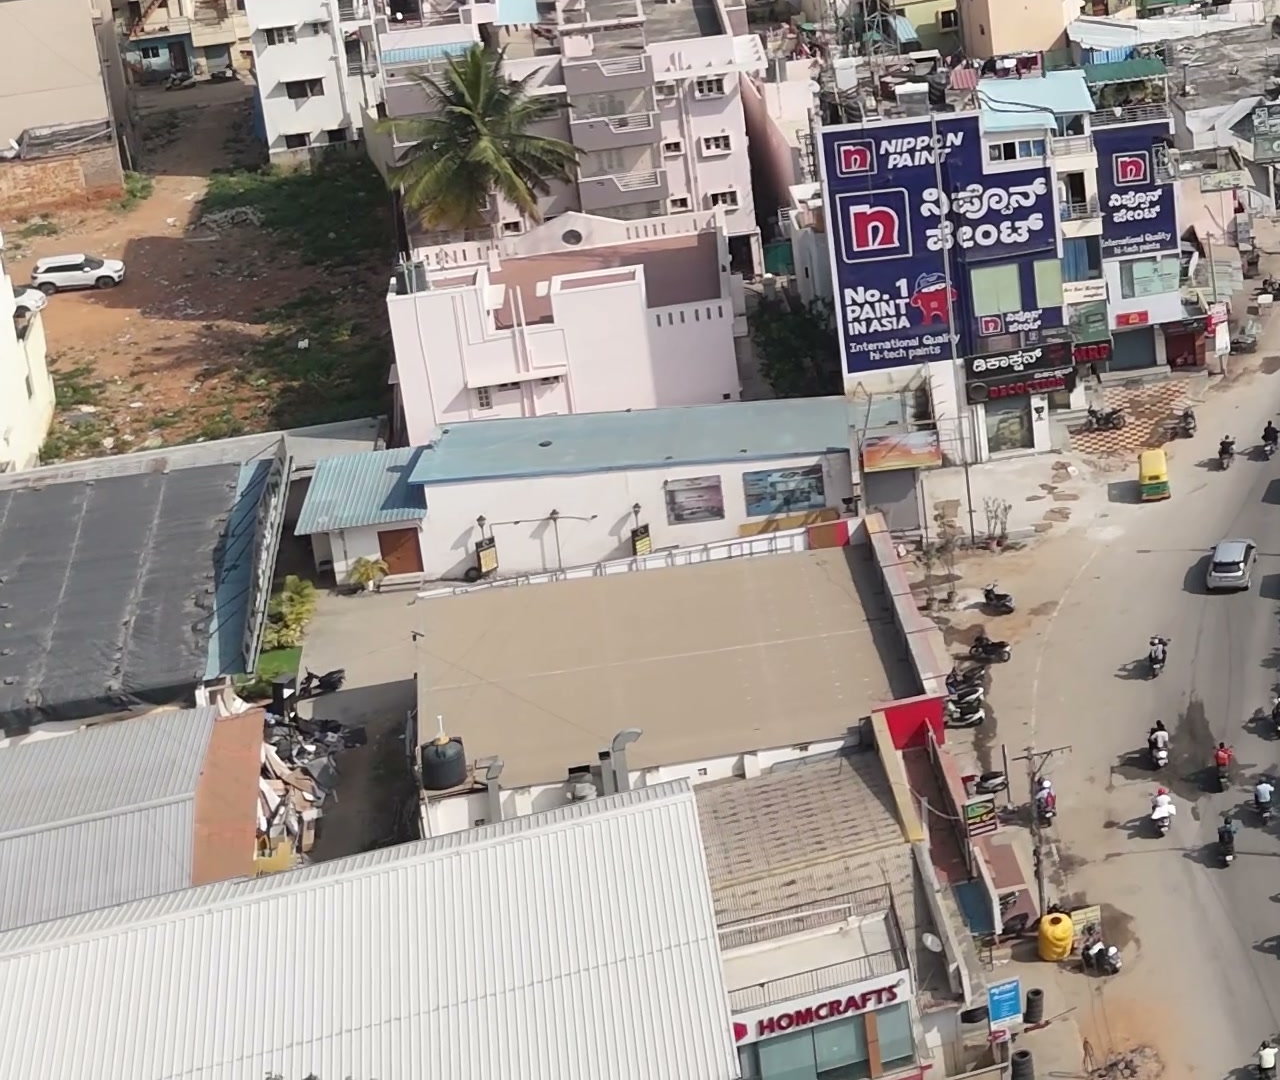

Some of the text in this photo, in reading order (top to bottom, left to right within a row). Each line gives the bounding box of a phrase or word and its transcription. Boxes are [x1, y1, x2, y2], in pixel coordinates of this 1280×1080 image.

[880, 132, 964, 155] NIPPON
[888, 148, 951, 169] PAINT
[1101, 232, 1171, 248] International Quality
[1140, 242, 1160, 252] paints
[844, 278, 908, 305] No. 1
[846, 298, 909, 321] PAINT
[848, 316, 910, 335] IN ASIA
[850, 337, 918, 353] International
[870, 346, 940, 360] hi-tech paints
[989, 377, 1066, 398] DECOCTION
[757, 984, 898, 1036] HOMCRAFTS
